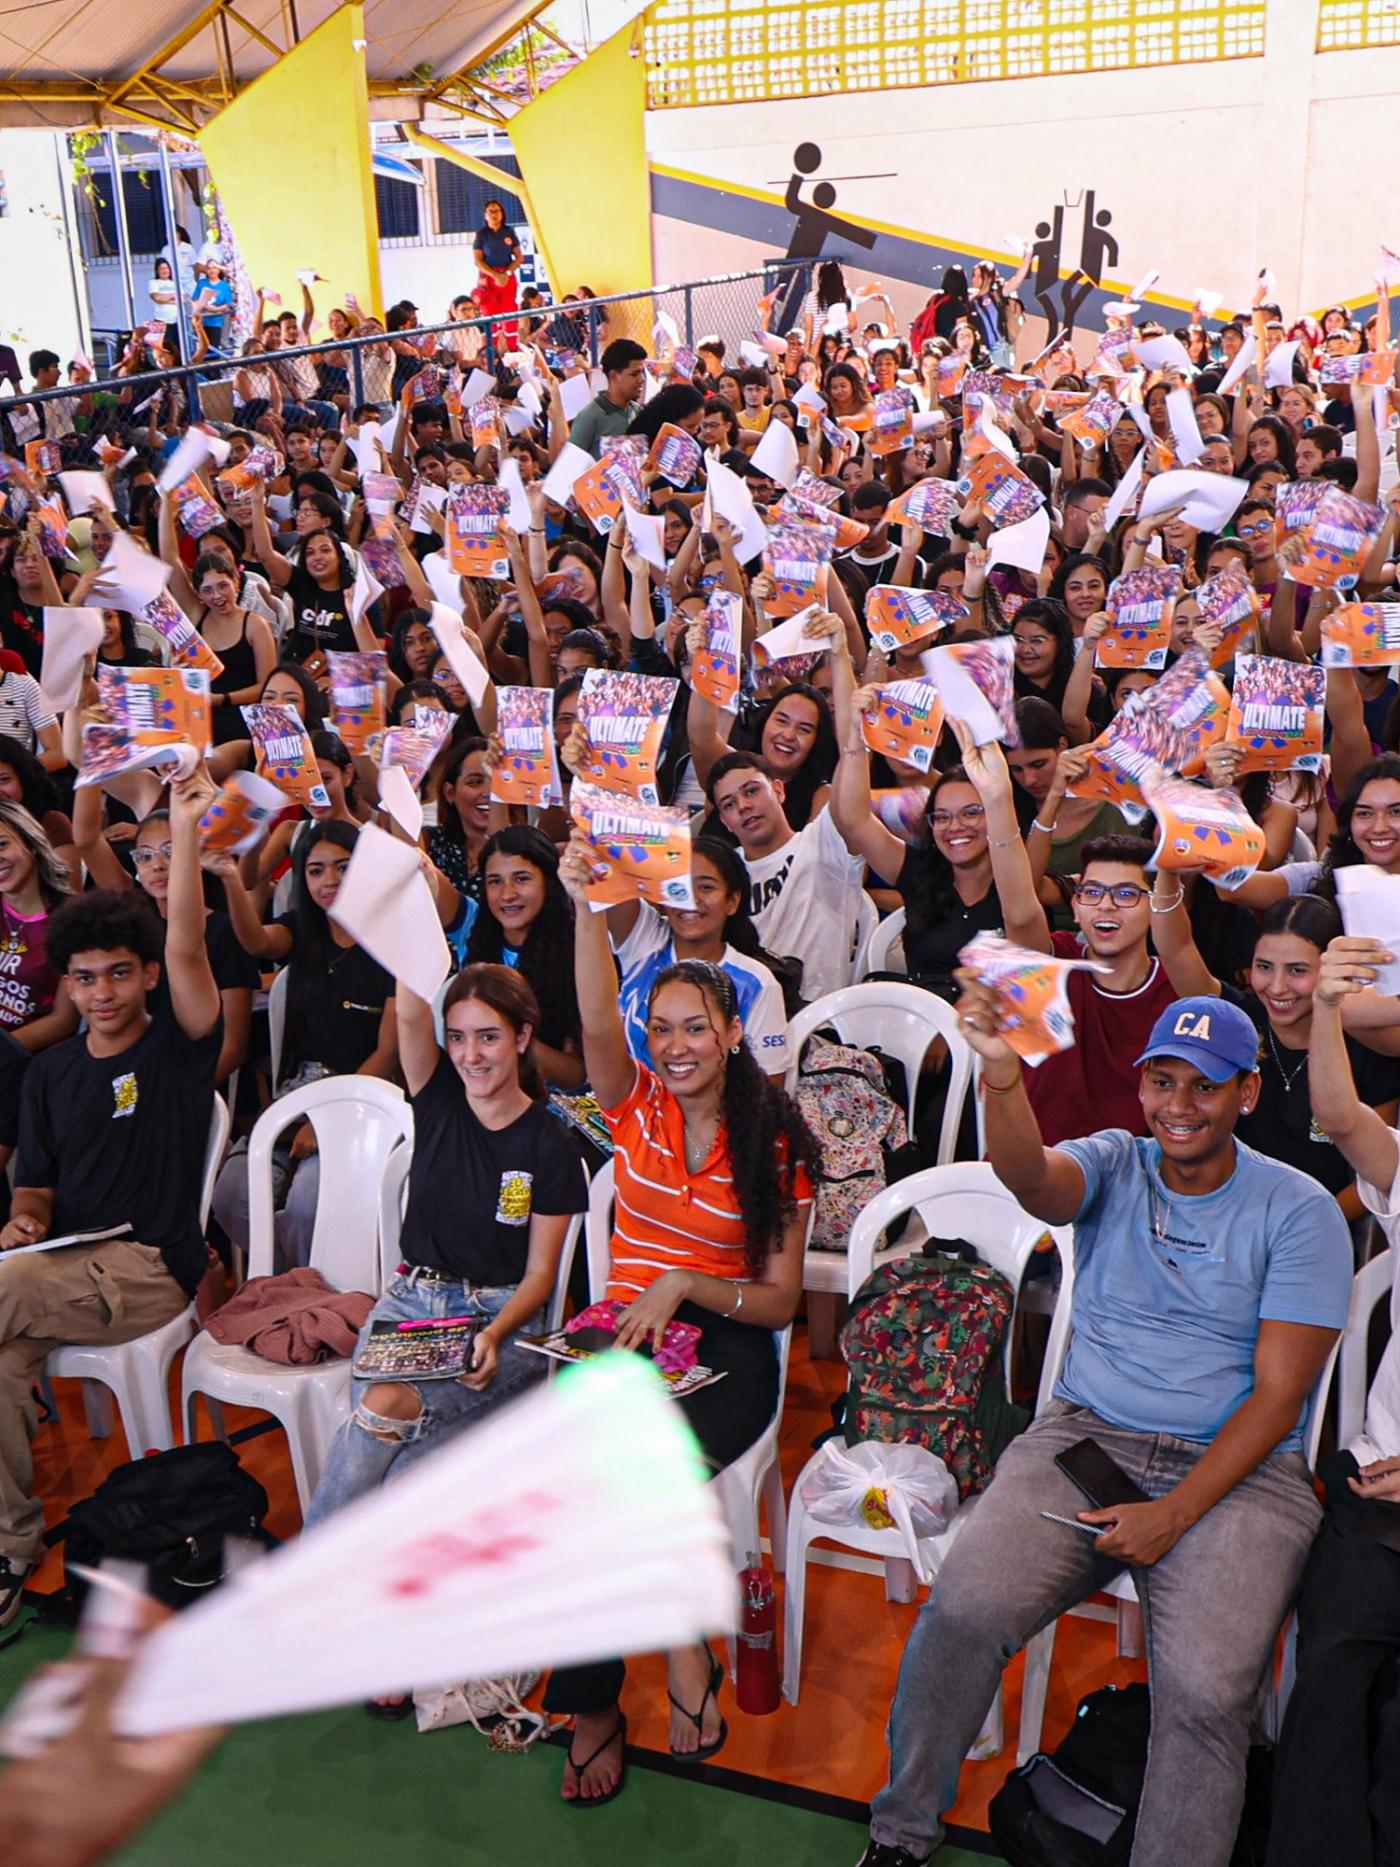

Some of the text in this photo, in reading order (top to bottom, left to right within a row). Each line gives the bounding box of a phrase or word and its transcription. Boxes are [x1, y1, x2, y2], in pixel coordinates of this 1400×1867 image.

[457, 514, 500, 536] ULTIMATE
[301, 608, 334, 627] cdf
[588, 716, 649, 744] ULTIMATE
[1244, 704, 1306, 730] ULTIMATE
[266, 735, 304, 761] ULTIMATE
[592, 811, 667, 837] ULTIMATE
[1174, 1012, 1210, 1040] CA
